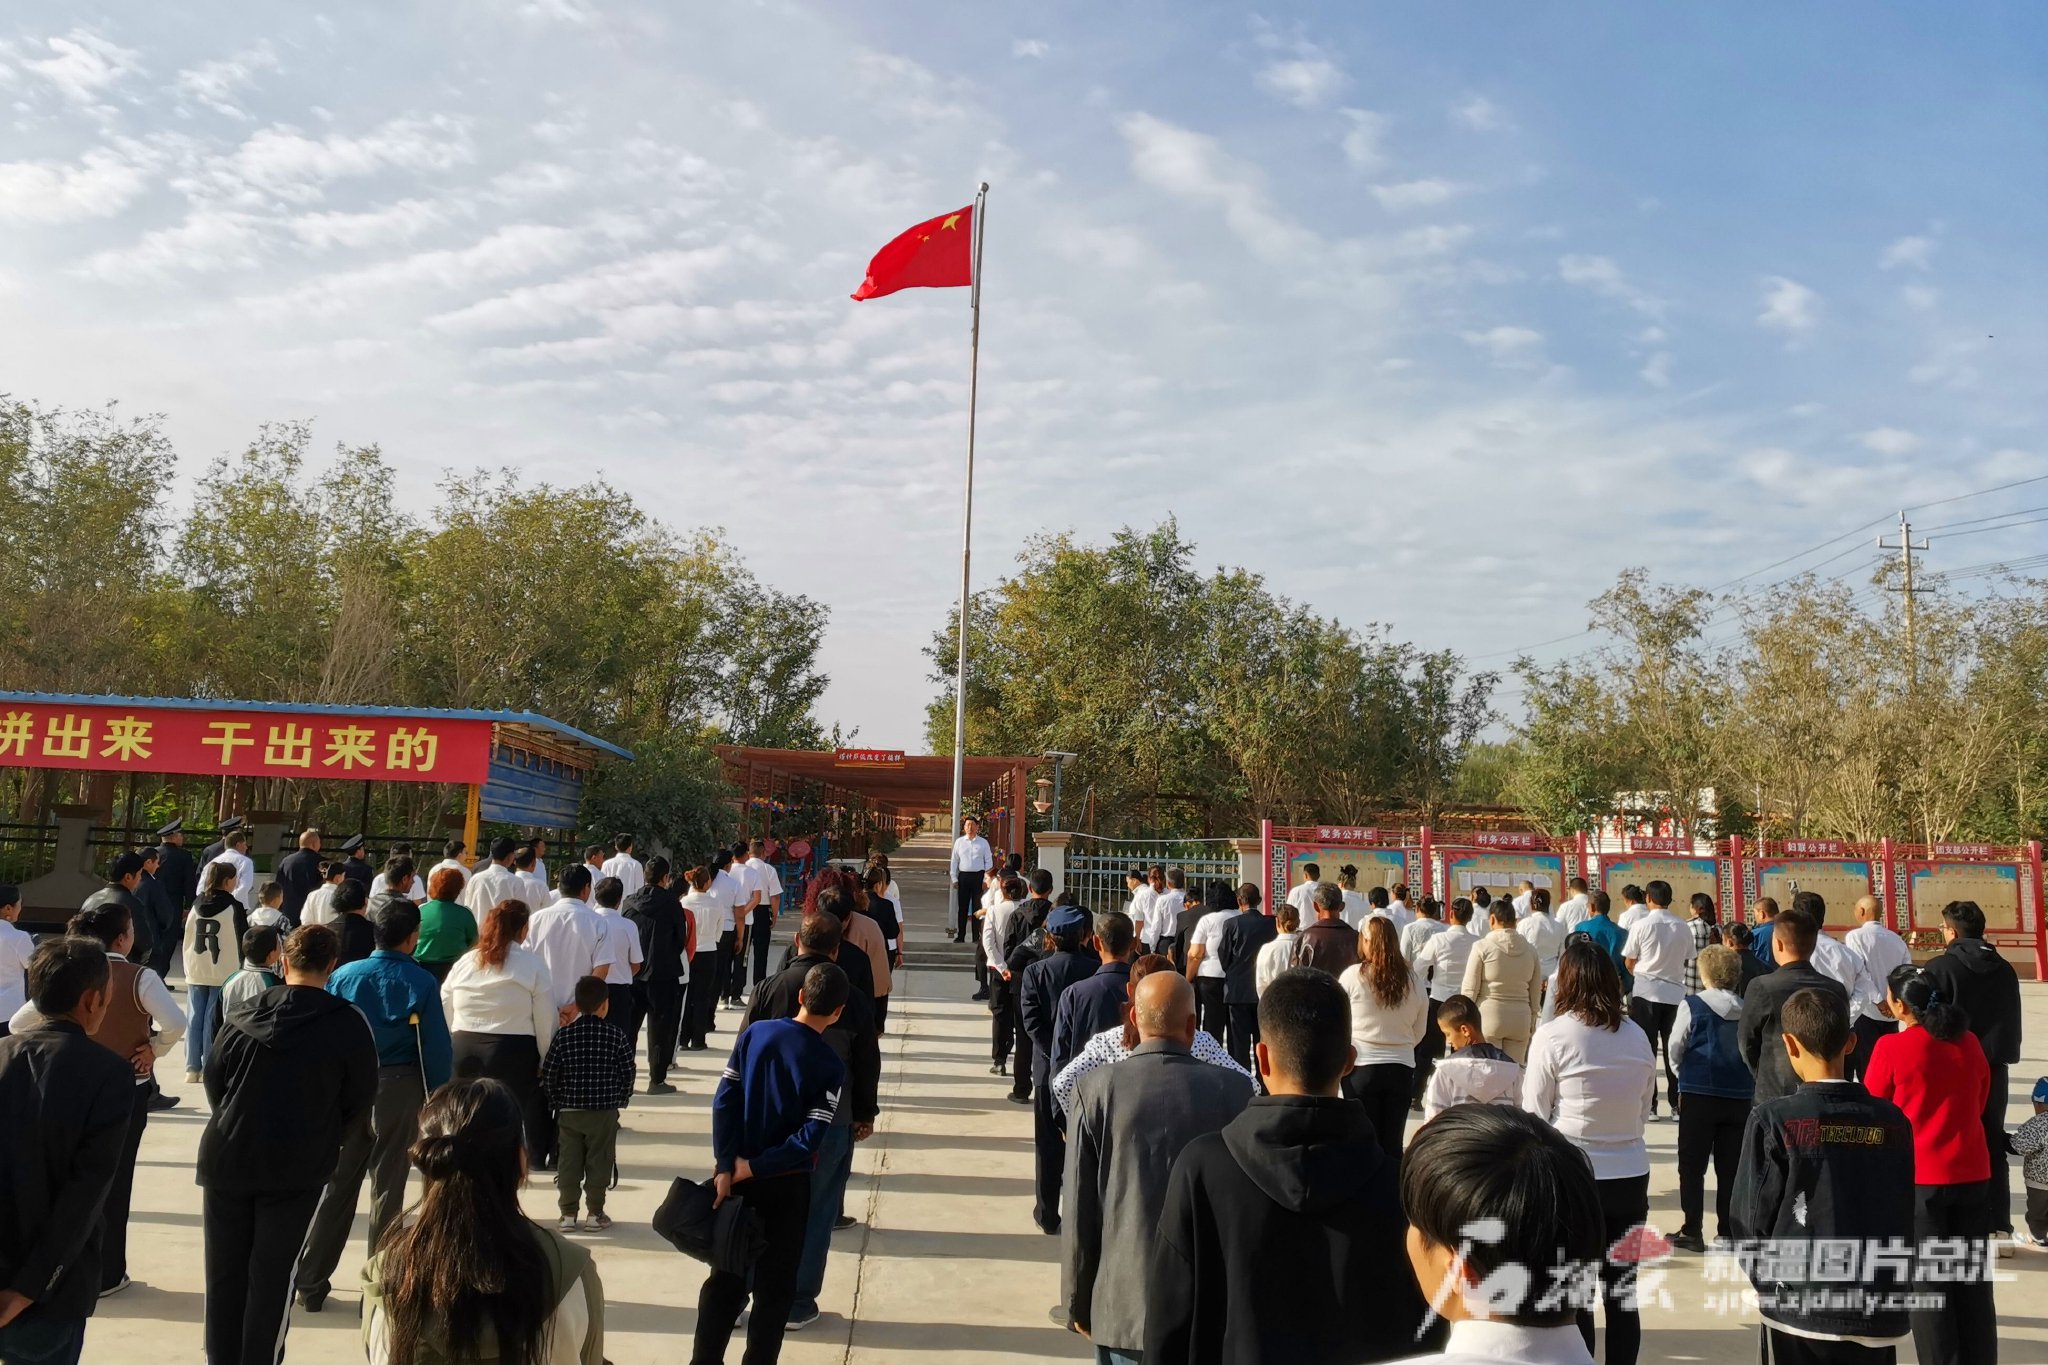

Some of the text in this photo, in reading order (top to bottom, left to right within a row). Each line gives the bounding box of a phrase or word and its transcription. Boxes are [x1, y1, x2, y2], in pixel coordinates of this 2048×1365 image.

[0, 711, 438, 772] 拼出来 干出来的
[1320, 828, 1374, 840] 党务公开栏
[1477, 834, 1532, 846] 村务公开栏
[1633, 839, 1686, 850] 财务公开栏
[1787, 841, 1838, 853] 妇联公开栏
[1935, 844, 1988, 855] 团支部公开栏
[193, 918, 221, 965] R
